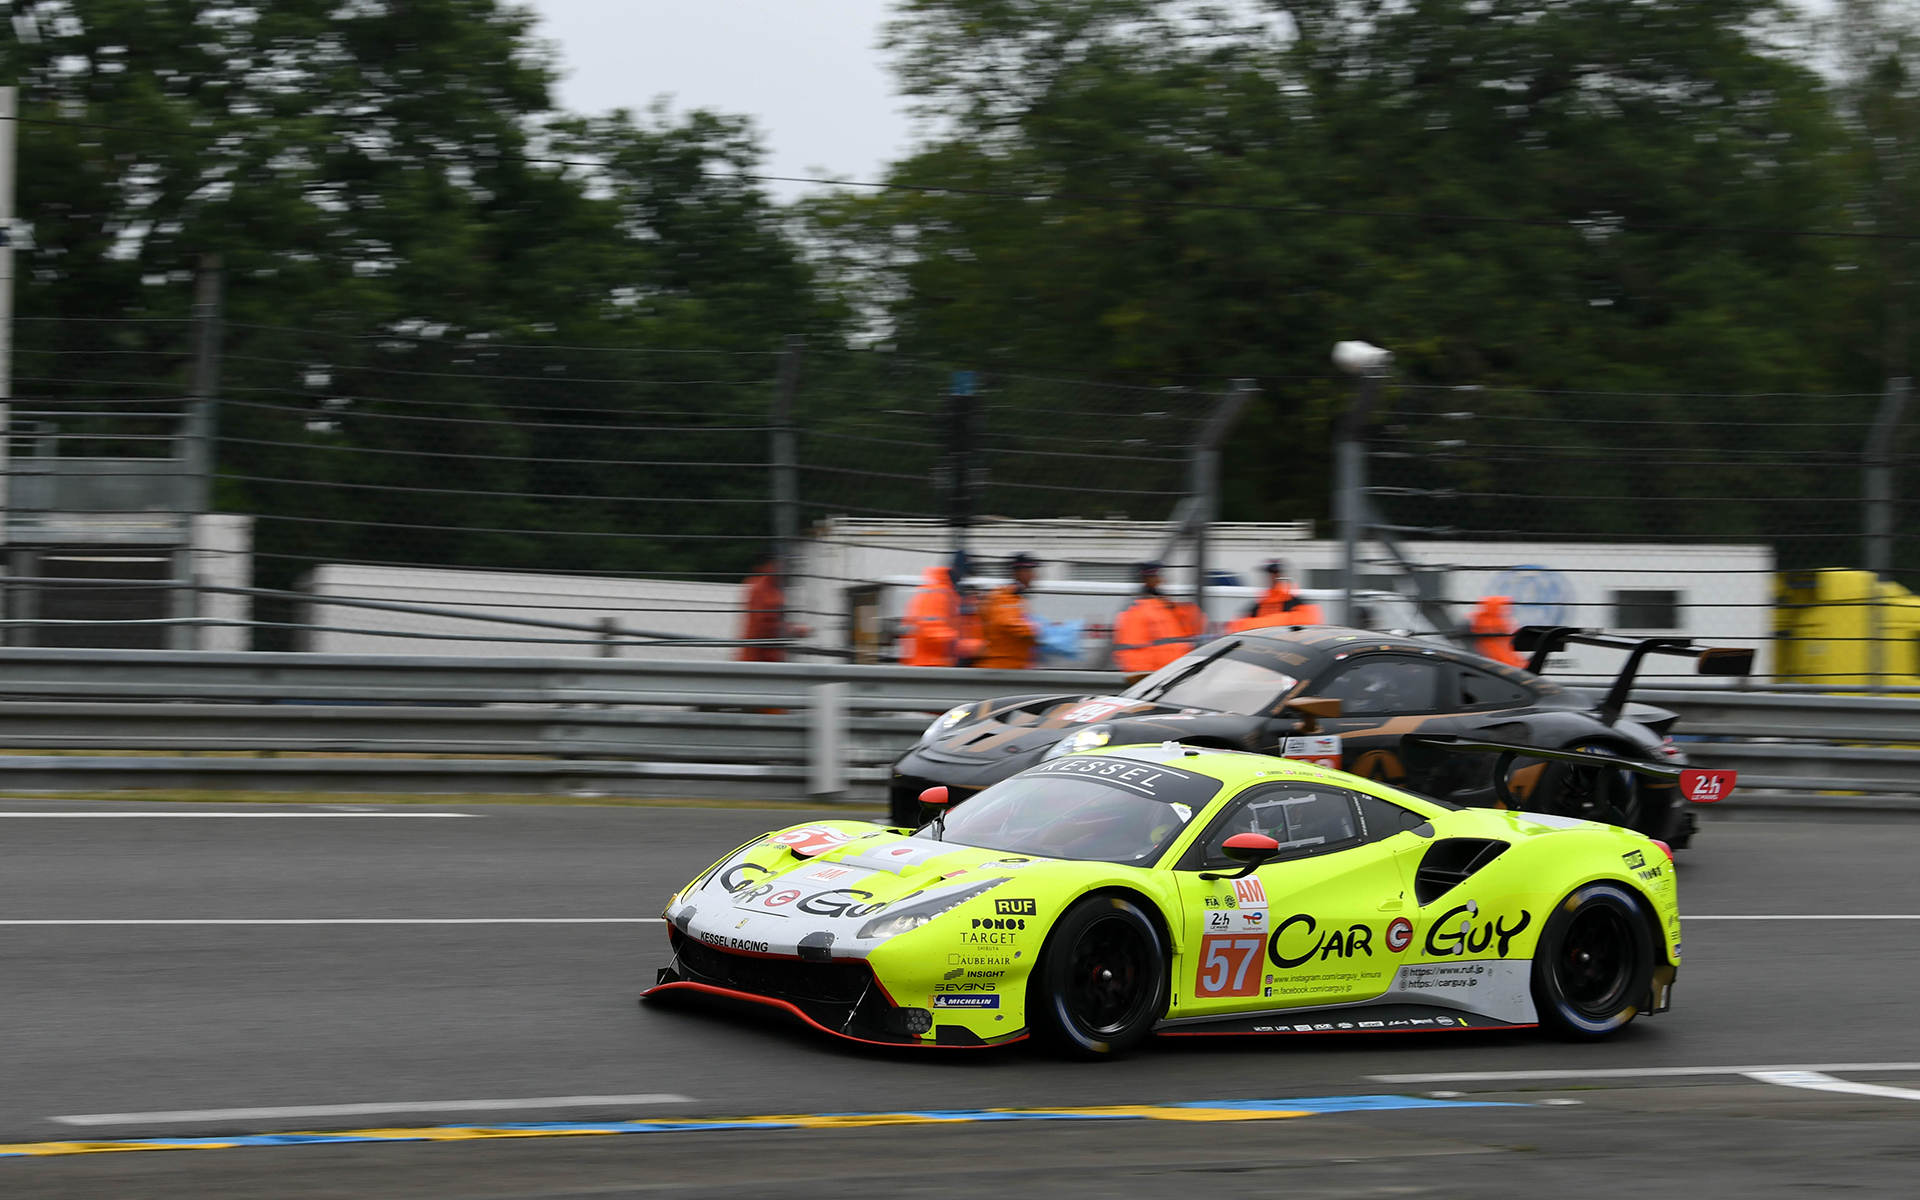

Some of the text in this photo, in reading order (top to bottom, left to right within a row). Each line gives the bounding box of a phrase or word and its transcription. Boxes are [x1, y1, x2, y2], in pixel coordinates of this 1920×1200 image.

[1040, 760, 1162, 788] KESSEL
[773, 828, 852, 855] 57
[1235, 880, 1265, 902] AM
[998, 900, 1033, 913] RUF
[1205, 898, 1220, 907] FIA
[972, 918, 1026, 931] PONOS
[701, 931, 769, 953] KESSEL RACING
[960, 932, 1016, 944] TARGET
[1268, 913, 1373, 969] CAR
[1425, 904, 1531, 959] GUY
[960, 957, 1011, 965] AUBE HAIR
[1203, 939, 1260, 992] 57
[967, 970, 1005, 978] INSIGHT
[1408, 977, 1478, 989] https://carguy.jp
